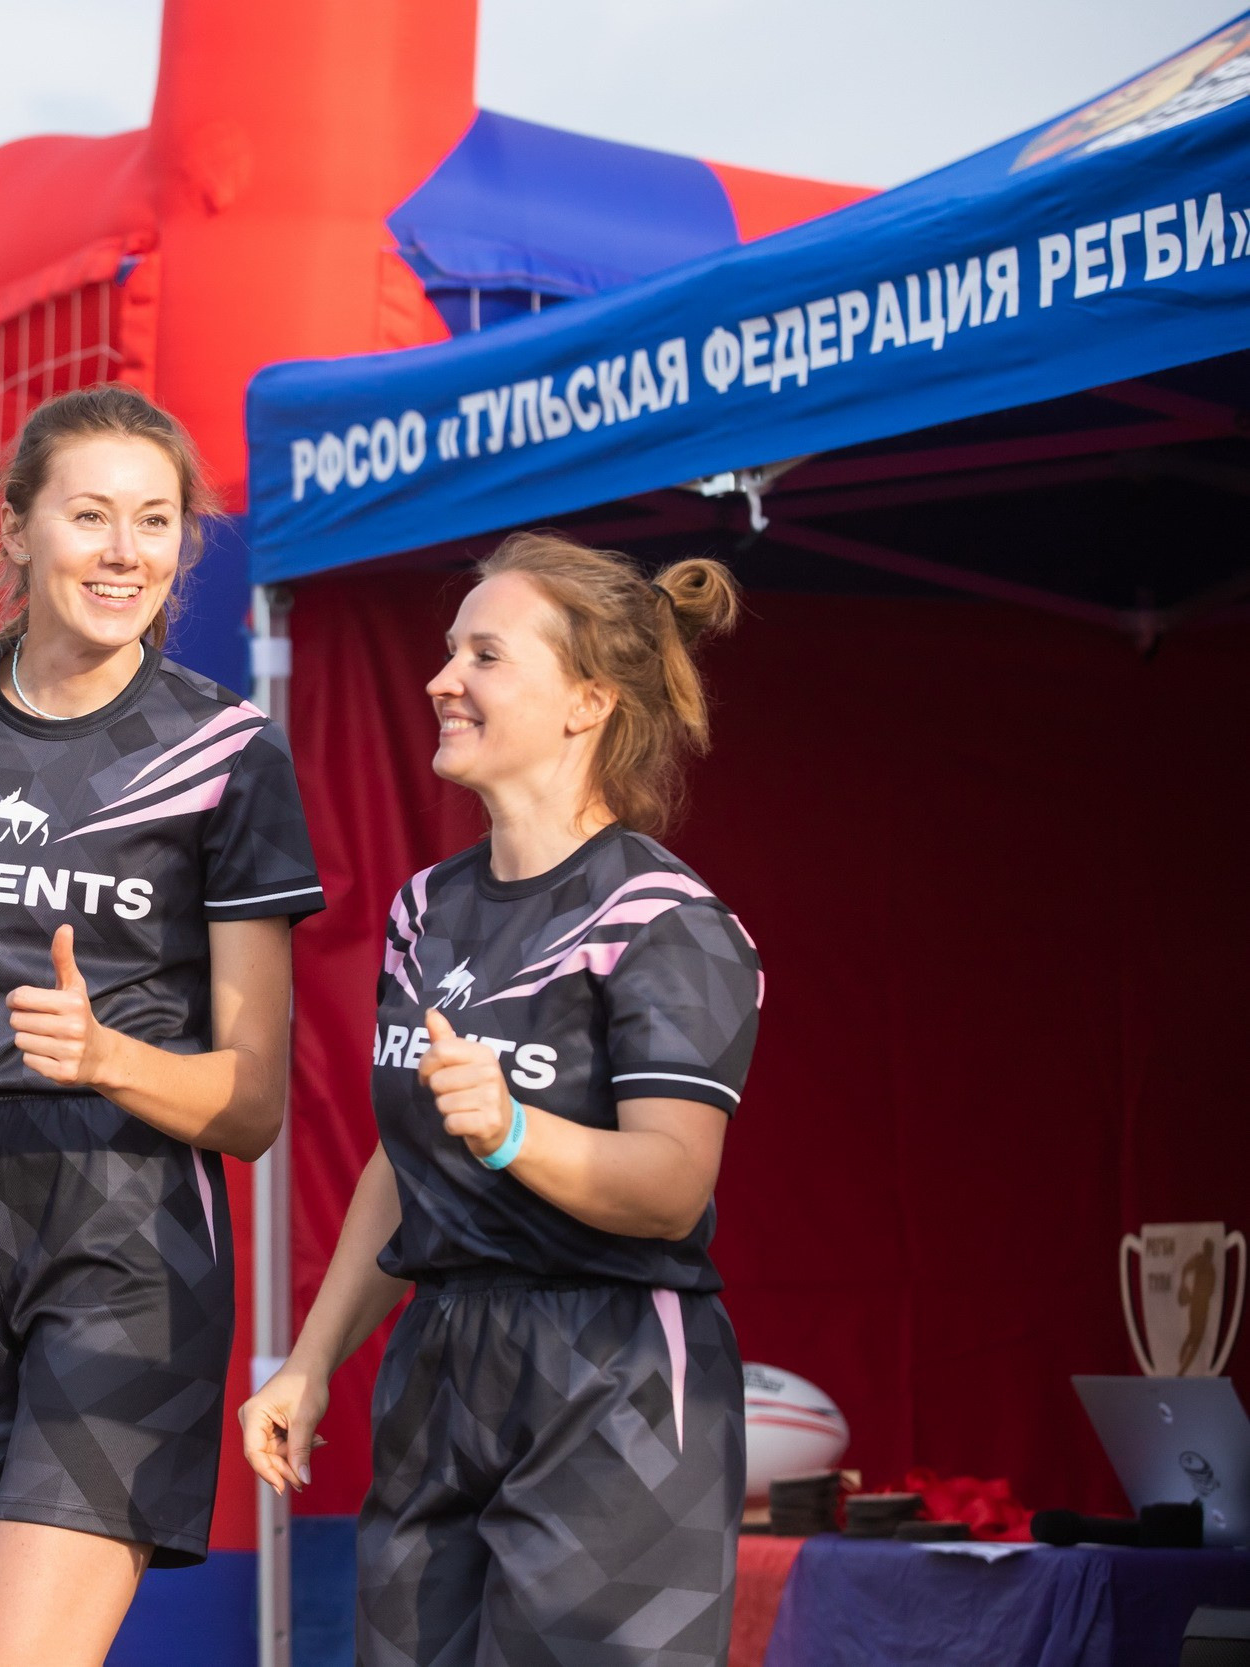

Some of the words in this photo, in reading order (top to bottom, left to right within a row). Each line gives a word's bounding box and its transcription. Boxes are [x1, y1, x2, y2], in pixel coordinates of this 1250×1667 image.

[291, 410, 427, 501] РФСОО
[437, 337, 689, 462] «ТУЛЬСКАЯ
[703, 246, 1019, 394] ФЕДЕРАЦИЯ
